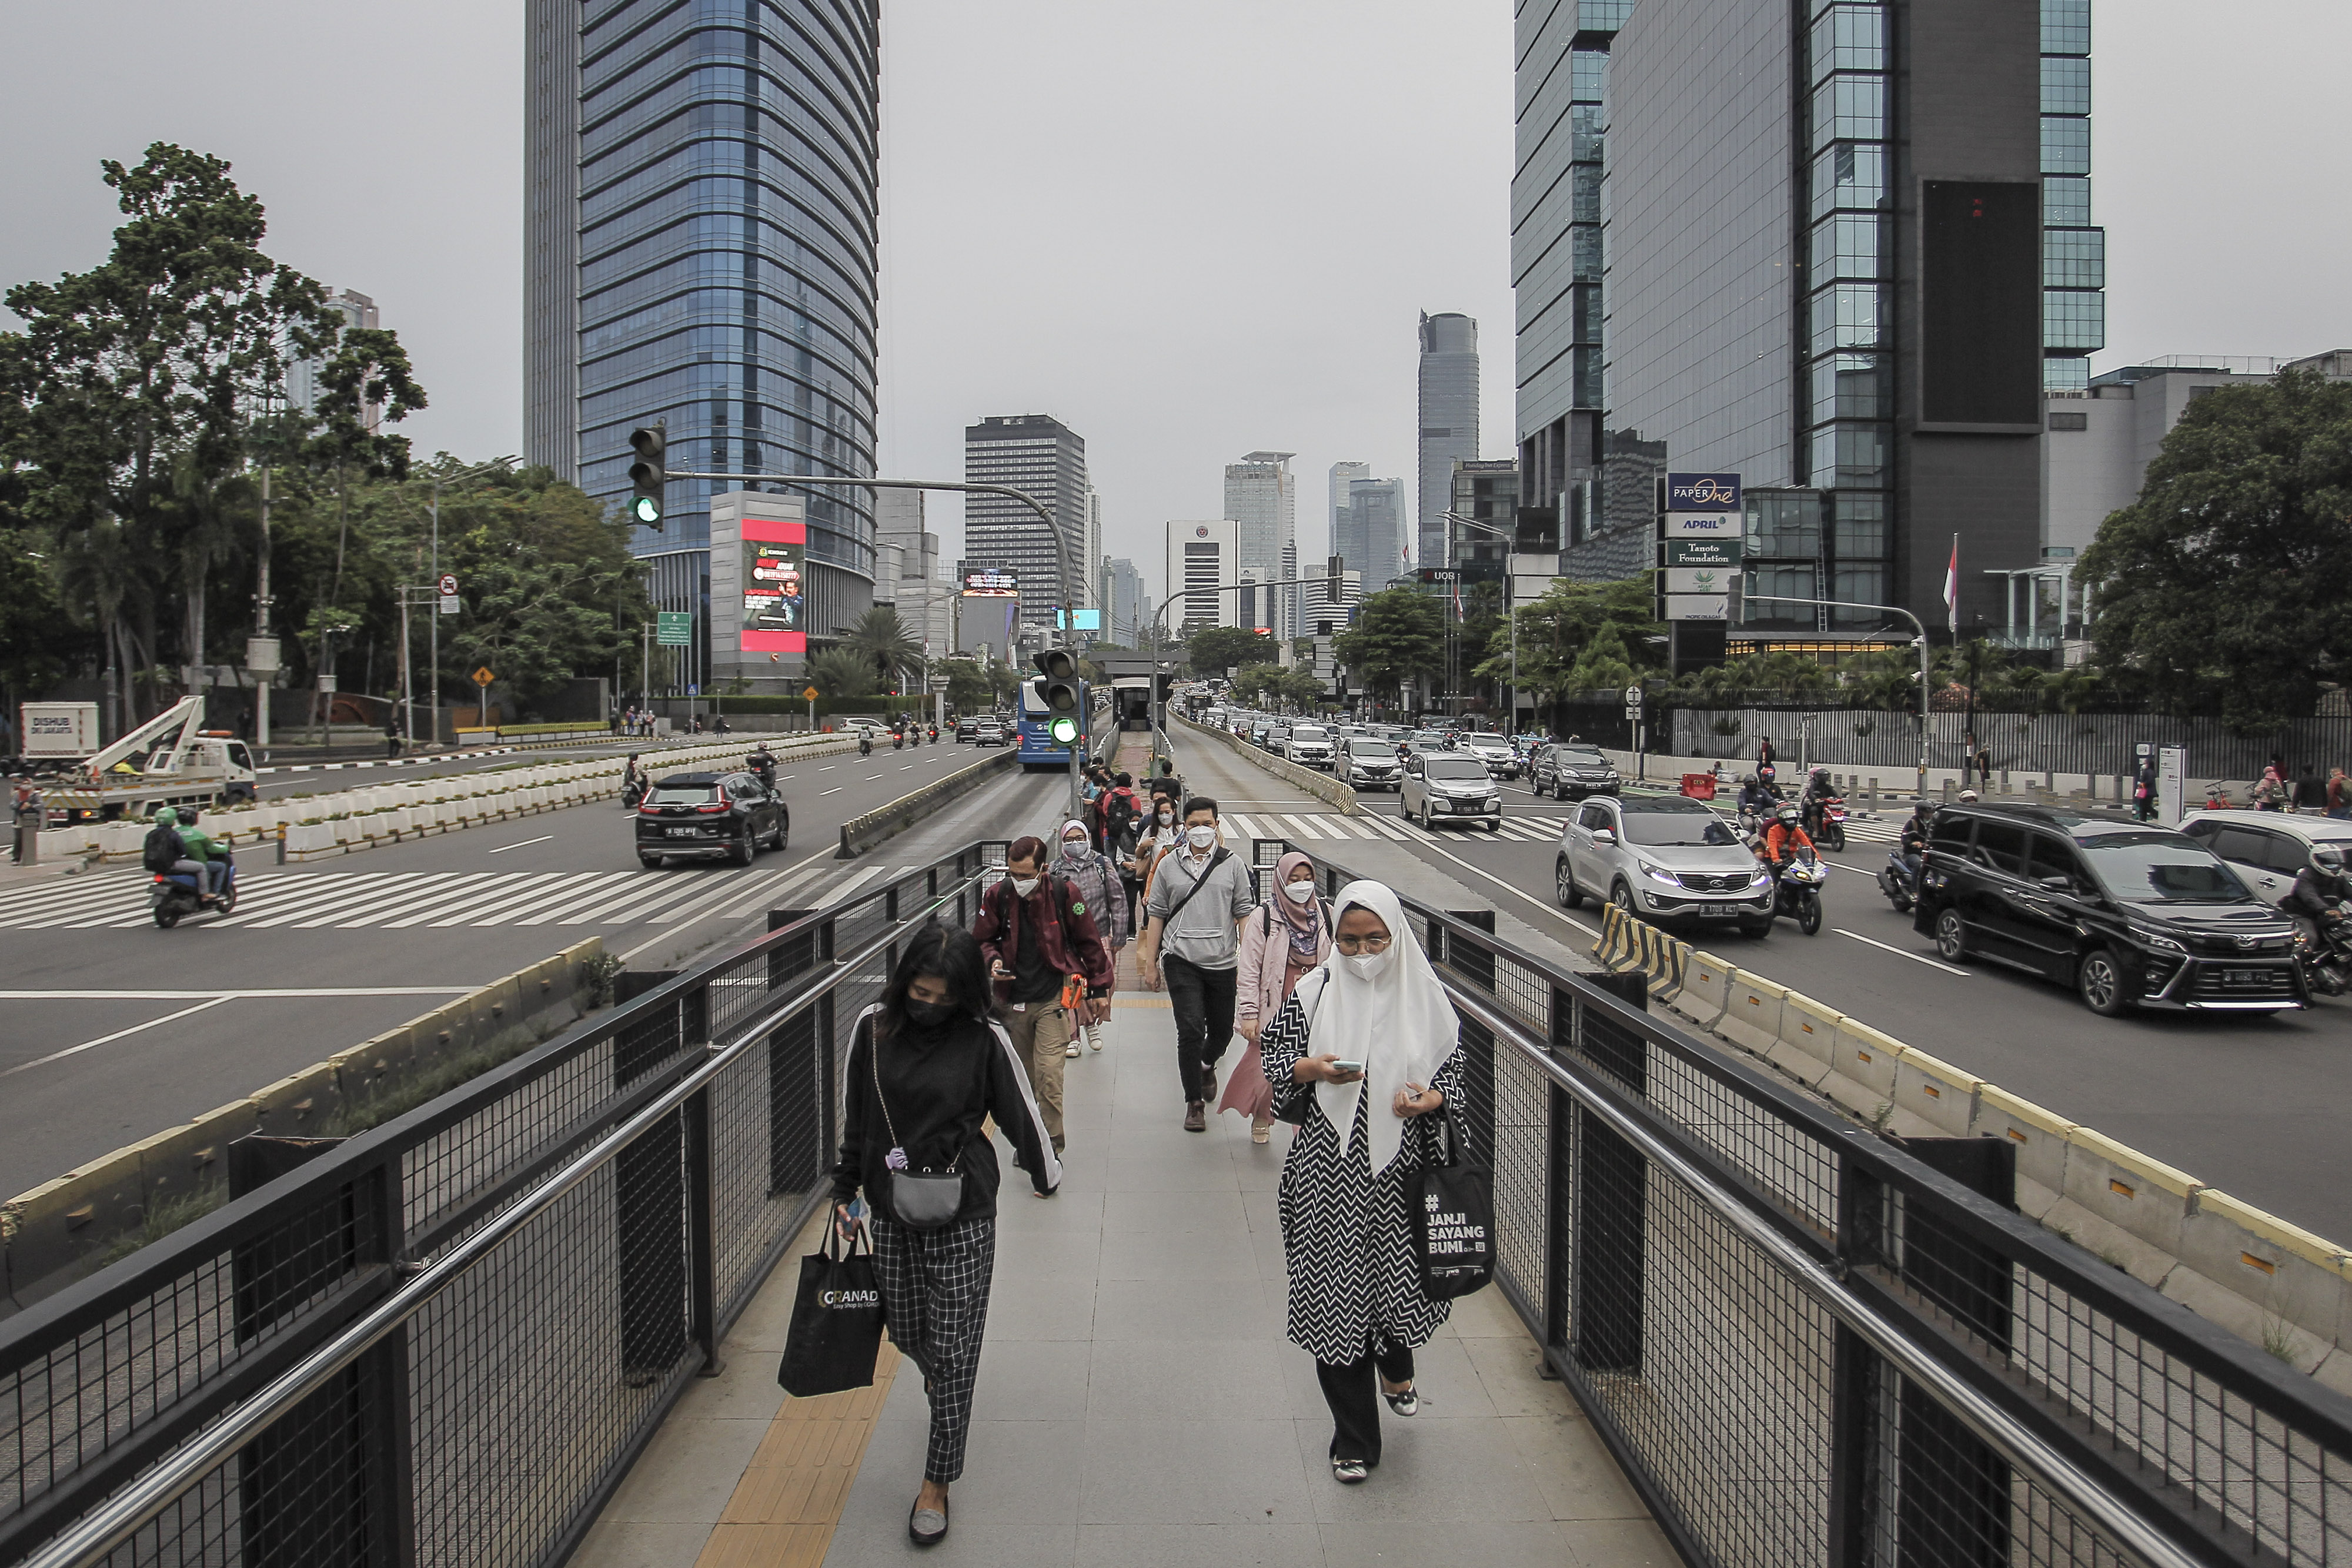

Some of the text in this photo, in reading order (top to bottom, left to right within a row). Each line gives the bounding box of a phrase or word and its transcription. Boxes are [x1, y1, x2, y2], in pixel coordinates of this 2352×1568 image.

[1683, 520, 1719, 529] APRIL
[1688, 543, 1719, 552] Tanoto
[1679, 553, 1729, 562] Foundation
[1435, 571, 1455, 580] UOB
[34, 717, 69, 726] DISHUB
[1425, 1195, 1439, 1212] #
[1427, 1213, 1466, 1226] JANJI
[1428, 1226, 1484, 1240] SAYANG
[1429, 1241, 1463, 1253] BUMI
